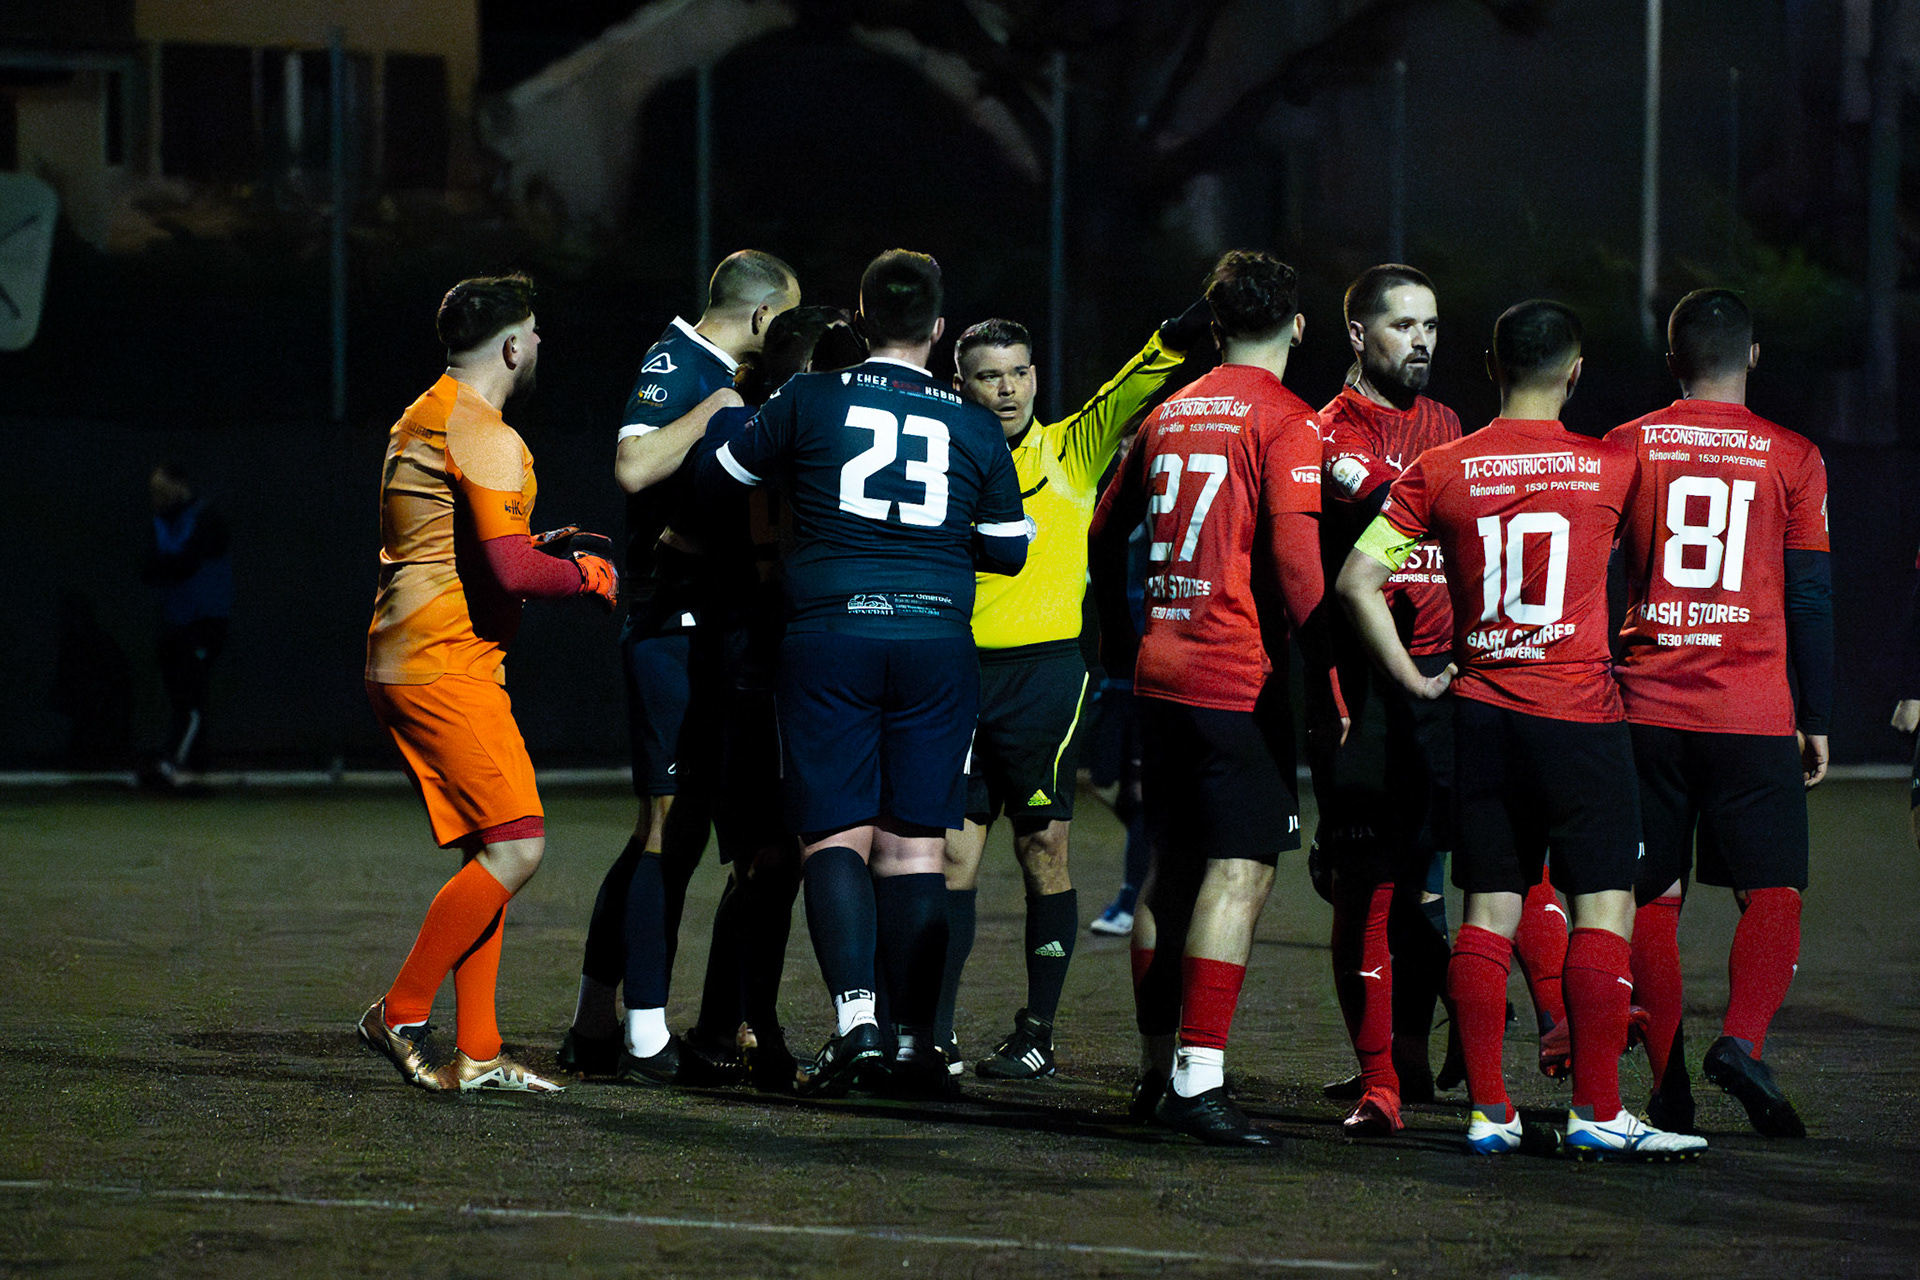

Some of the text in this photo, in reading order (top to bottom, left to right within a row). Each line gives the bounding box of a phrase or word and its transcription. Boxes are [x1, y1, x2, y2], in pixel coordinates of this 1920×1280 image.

[1641, 424, 1748, 449] TA-CONSTRUCTION
[839, 405, 951, 527] 23
[1461, 452, 1575, 479] TA-CONSTRUCTION
[1649, 448, 1767, 468] Rénovation 1530 PAYERNE
[1470, 481, 1600, 497] Rénovation 1530 PAYERNE
[1149, 453, 1229, 562] 27
[1663, 475, 1757, 593] 81
[1476, 512, 1571, 625] 10
[1687, 601, 1751, 627] STORES
[1657, 633, 1682, 647] 1530
